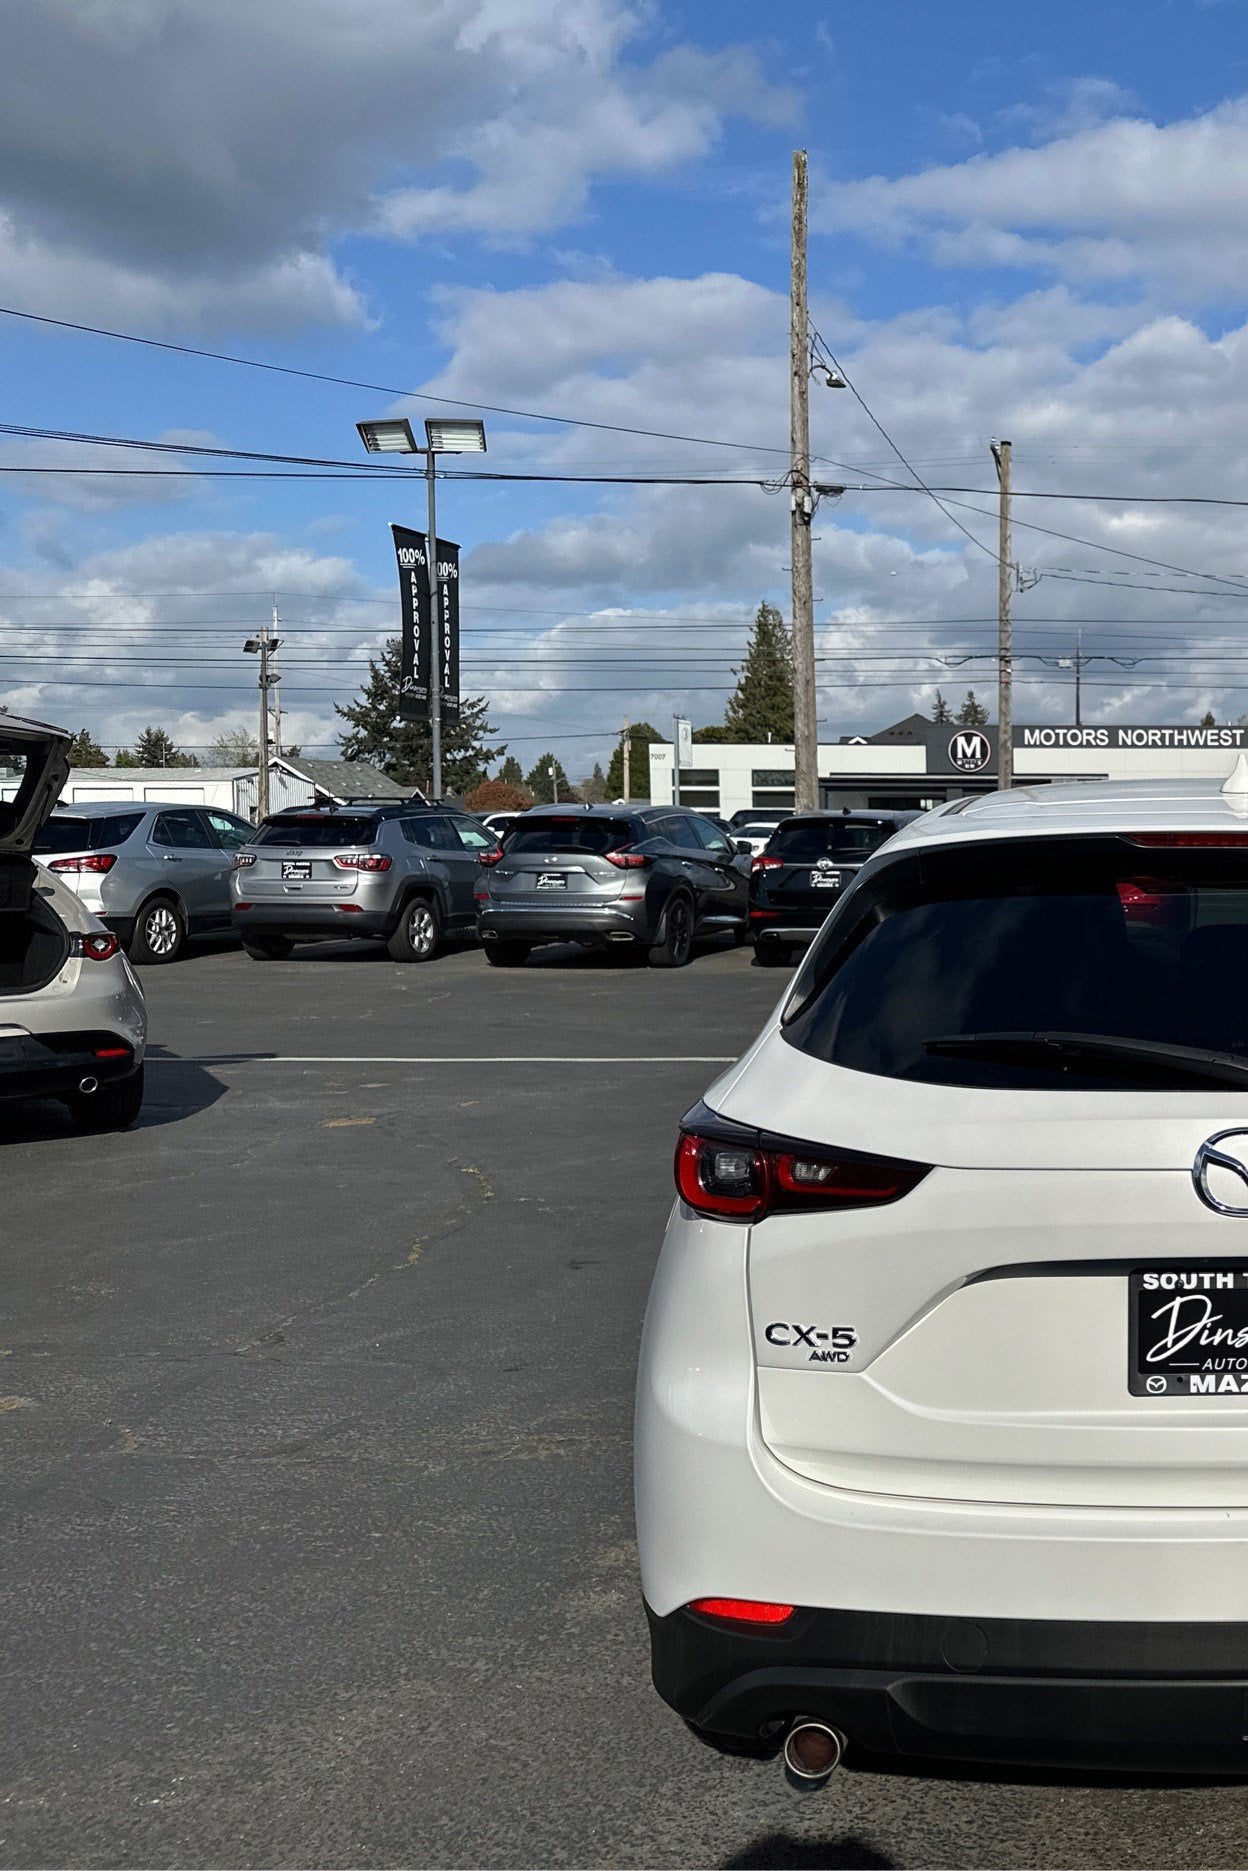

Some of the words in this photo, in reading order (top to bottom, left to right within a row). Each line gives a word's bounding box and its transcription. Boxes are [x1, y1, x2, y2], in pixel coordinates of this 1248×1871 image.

[397, 547, 426, 566] 100%
[436, 561, 458, 579] 00%
[410, 571, 420, 679] APPROVAL
[442, 584, 451, 688] APPROVAL
[1023, 728, 1109, 746] MOTORS
[1118, 729, 1245, 746] NORTHWEST
[956, 736, 982, 759] M
[1142, 1272, 1234, 1290] SOUTH
[765, 1322, 857, 1349] CX-5
[808, 1350, 850, 1363] AWD
[1202, 1358, 1248, 1371] AUTO
